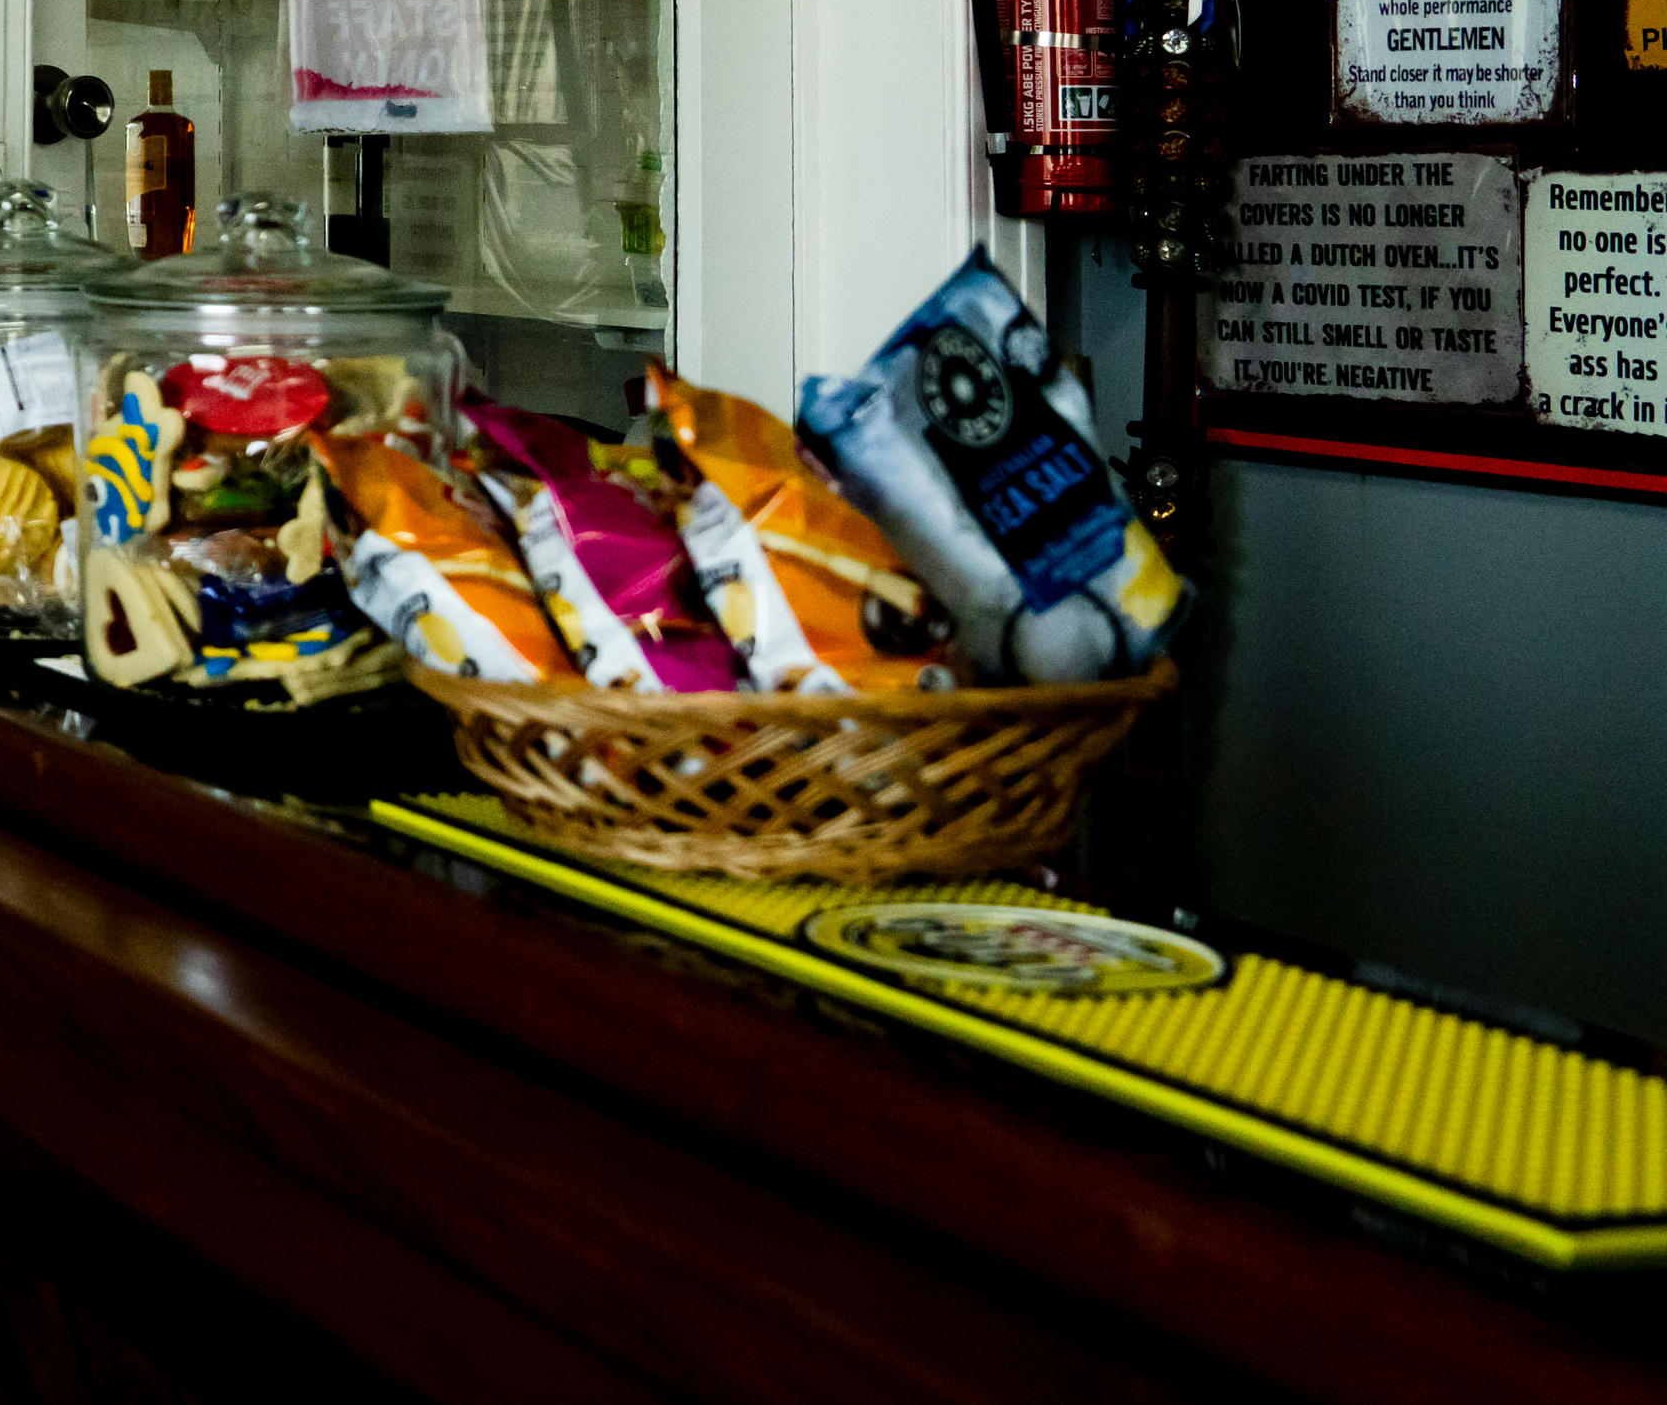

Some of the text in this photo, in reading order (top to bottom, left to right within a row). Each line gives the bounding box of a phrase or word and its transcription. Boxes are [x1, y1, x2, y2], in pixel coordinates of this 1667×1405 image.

[1387, 27, 1505, 51] GENTLEMEN
[1022, 73, 1033, 98] ABE
[1349, 64, 1543, 84] Stand closer it may be shorter
[1395, 91, 1494, 111] than you think
[1250, 163, 1453, 186] FARTING UNDER THE
[1240, 204, 1464, 227] COVERS IS NO LONGER
[1560, 227, 1666, 255] no one is
[1291, 244, 1375, 267] A DUTCH
[1565, 266, 1660, 297] perfect.
[1222, 281, 1491, 311] NOW A COVID TEST, IF YOU
[1218, 320, 1497, 354] CAN STILL SMELL OR TASTE
[1234, 359, 1433, 391] IT YOU'RE NEGATIVE
[1569, 351, 1657, 381] ass has
[1539, 392, 1654, 422] a crack in
